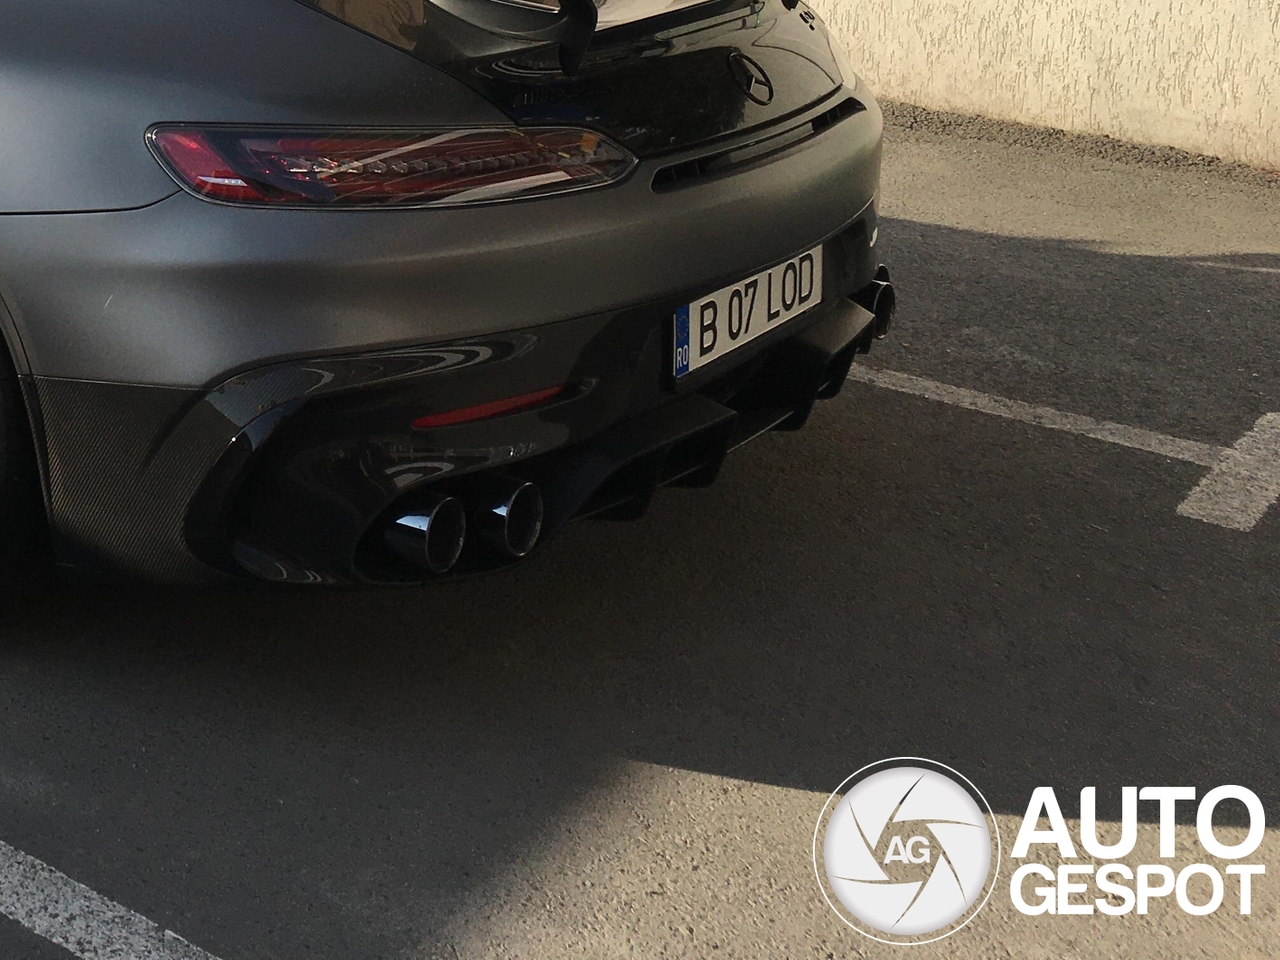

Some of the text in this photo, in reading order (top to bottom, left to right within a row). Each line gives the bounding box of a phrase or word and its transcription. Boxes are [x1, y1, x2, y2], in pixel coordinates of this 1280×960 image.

[699, 252, 814, 357] B 07 LOD
[676, 346, 689, 369] RO
